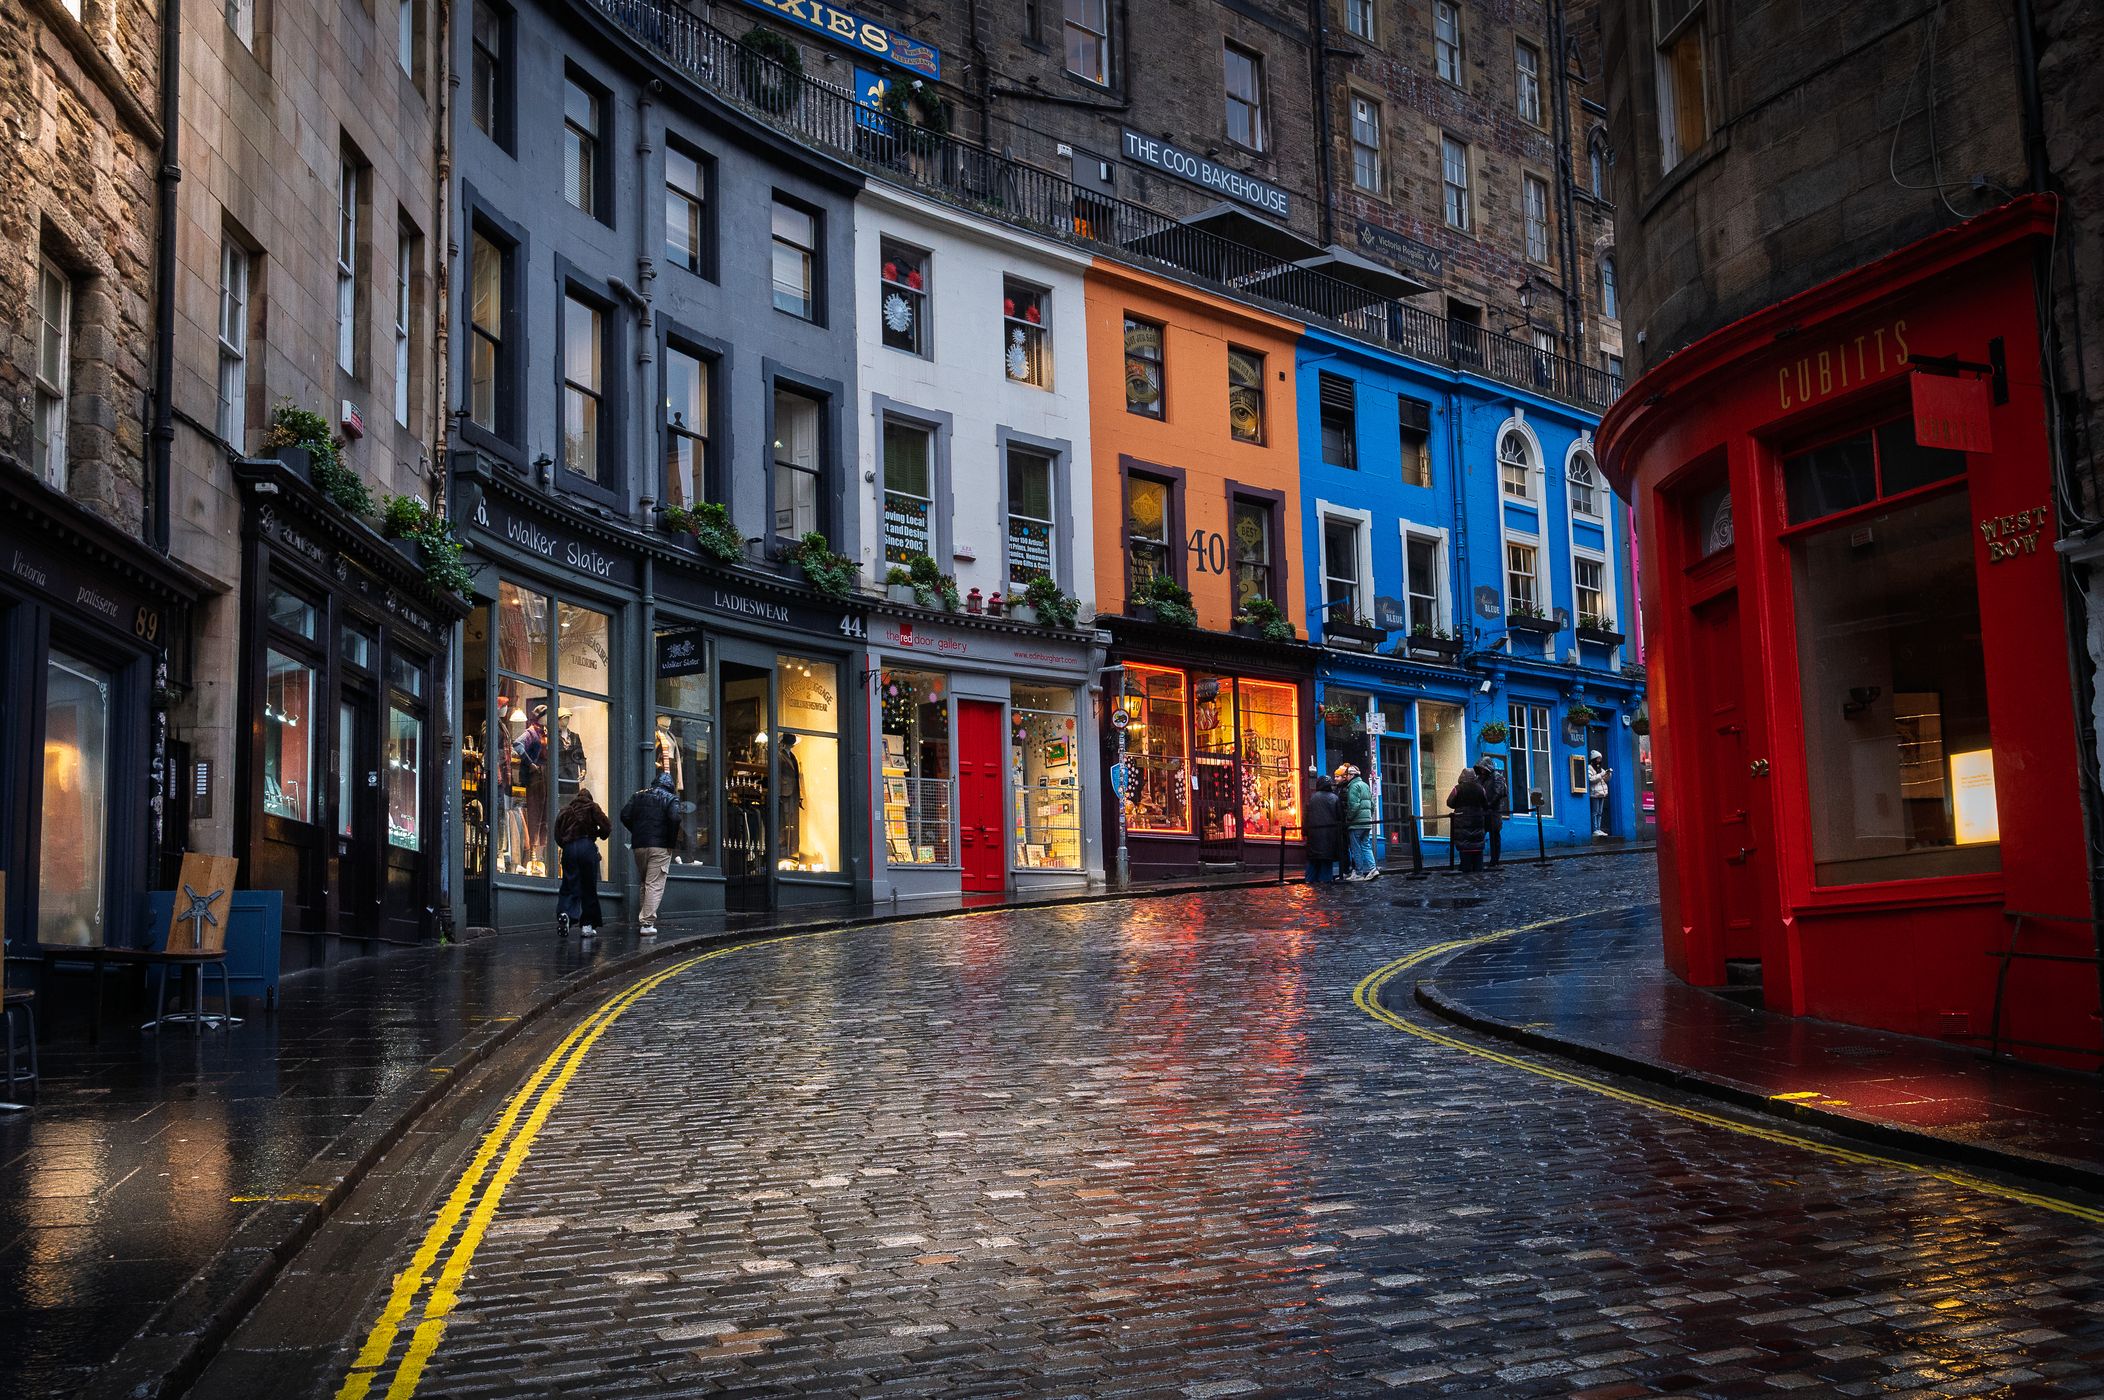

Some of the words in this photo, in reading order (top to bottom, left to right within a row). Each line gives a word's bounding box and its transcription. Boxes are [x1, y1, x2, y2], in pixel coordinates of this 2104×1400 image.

[753, 0, 888, 52] XIES
[1126, 132, 1159, 164] THE
[1163, 148, 1197, 178] COO
[1202, 163, 1287, 214] BAKEHOUSE
[1378, 235, 1402, 252] Victoria
[1402, 245, 1425, 261] Regalia
[1779, 319, 1910, 410] CUBITTS
[473, 495, 490, 528] 6.
[884, 511, 905, 524] oving
[906, 514, 925, 527] Local
[1980, 505, 2048, 542] WEST
[508, 516, 557, 556] Walker
[567, 542, 614, 577] Slater
[884, 534, 904, 547] Since
[904, 538, 923, 552] 2003
[890, 525, 904, 535] and
[904, 526, 929, 541] Design
[1242, 527, 1257, 538] BEST
[1988, 530, 2040, 562] BOW
[1188, 529, 1225, 575] 40
[13, 550, 47, 587] Victoria
[76, 586, 119, 617] patisserie
[136, 606, 159, 641] 89
[714, 591, 789, 623] LADIESWEAR
[839, 614, 867, 639] 44.
[1386, 613, 1403, 624] BLEUE
[1485, 604, 1500, 614] BLEUE
[886, 629, 900, 641] the
[900, 632, 913, 643] red
[914, 633, 934, 646] door
[937, 637, 967, 653] gallery
[662, 661, 682, 669] Walker
[683, 658, 700, 667] Slater
